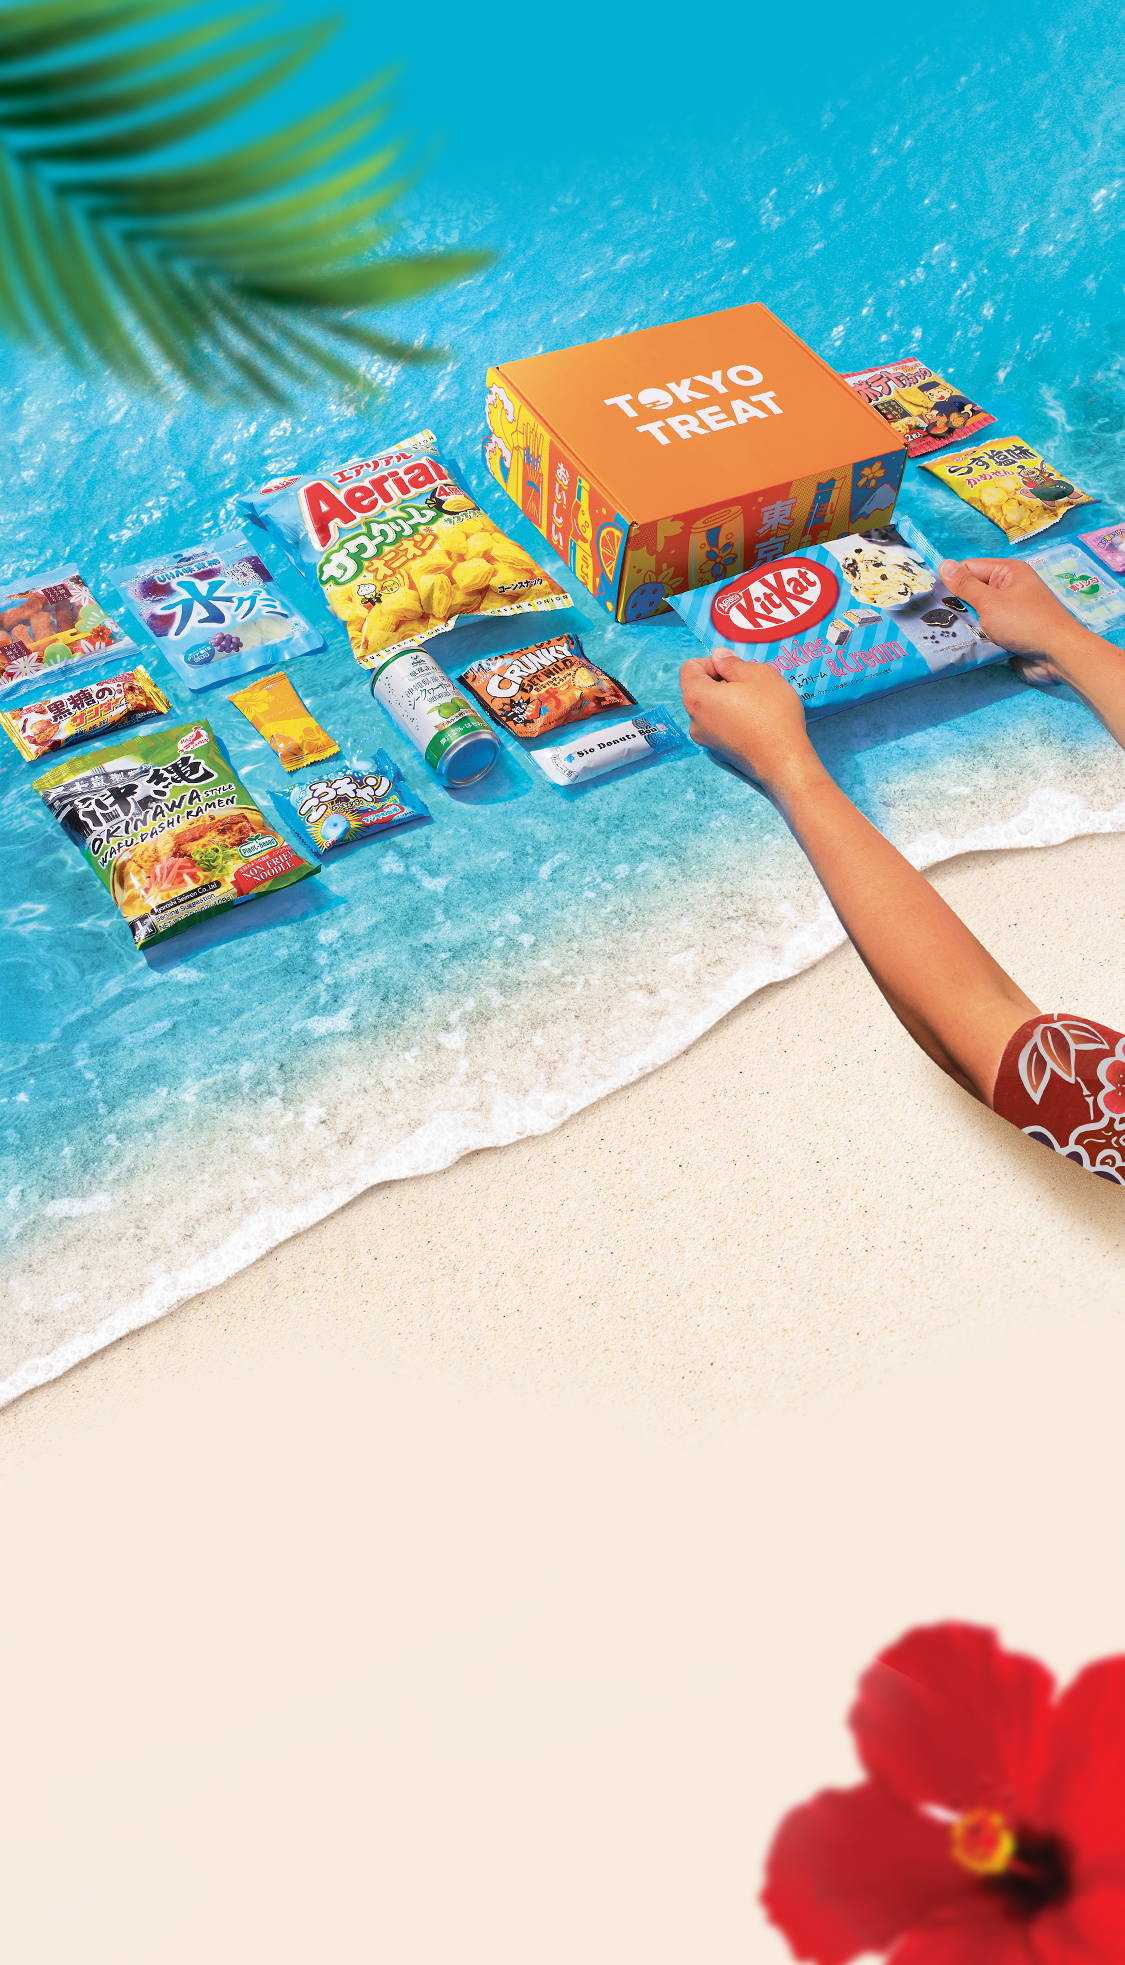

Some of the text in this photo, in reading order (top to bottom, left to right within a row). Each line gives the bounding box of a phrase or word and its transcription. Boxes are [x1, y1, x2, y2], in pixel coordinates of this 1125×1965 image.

[603, 364, 764, 418] TOKYO
[636, 391, 784, 446] TREAT
[333, 452, 414, 484] エアリアル
[945, 444, 1039, 477] うす塩味
[965, 468, 1015, 489] かめせん
[300, 458, 449, 550] Aerial
[549, 463, 571, 547] おいしい
[321, 506, 439, 584] サワークリーム
[751, 498, 797, 570] 東京
[497, 577, 544, 595] コーンスナック
[537, 594, 569, 606] ONION
[732, 566, 818, 628] KitKat
[160, 579, 290, 637] 水グミ
[486, 643, 574, 699] CRUNKY
[541, 658, 575, 680] WILD
[753, 638, 833, 674] okies
[47, 686, 114, 723] 黒糖の
[71, 696, 126, 727] サンダー
[576, 747, 595, 758] Sio
[597, 733, 637, 750] Donuts
[74, 755, 216, 828] 沖縄
[298, 775, 392, 824] ころキャン
[91, 783, 236, 855] OKINAWA STYLE
[99, 795, 237, 867] WAFU DASHI RAMEN
[241, 864, 264, 882] NON
[254, 859, 295, 885] NOODLE
[155, 905, 180, 923] Serving
[179, 893, 216, 913] Suggestion
